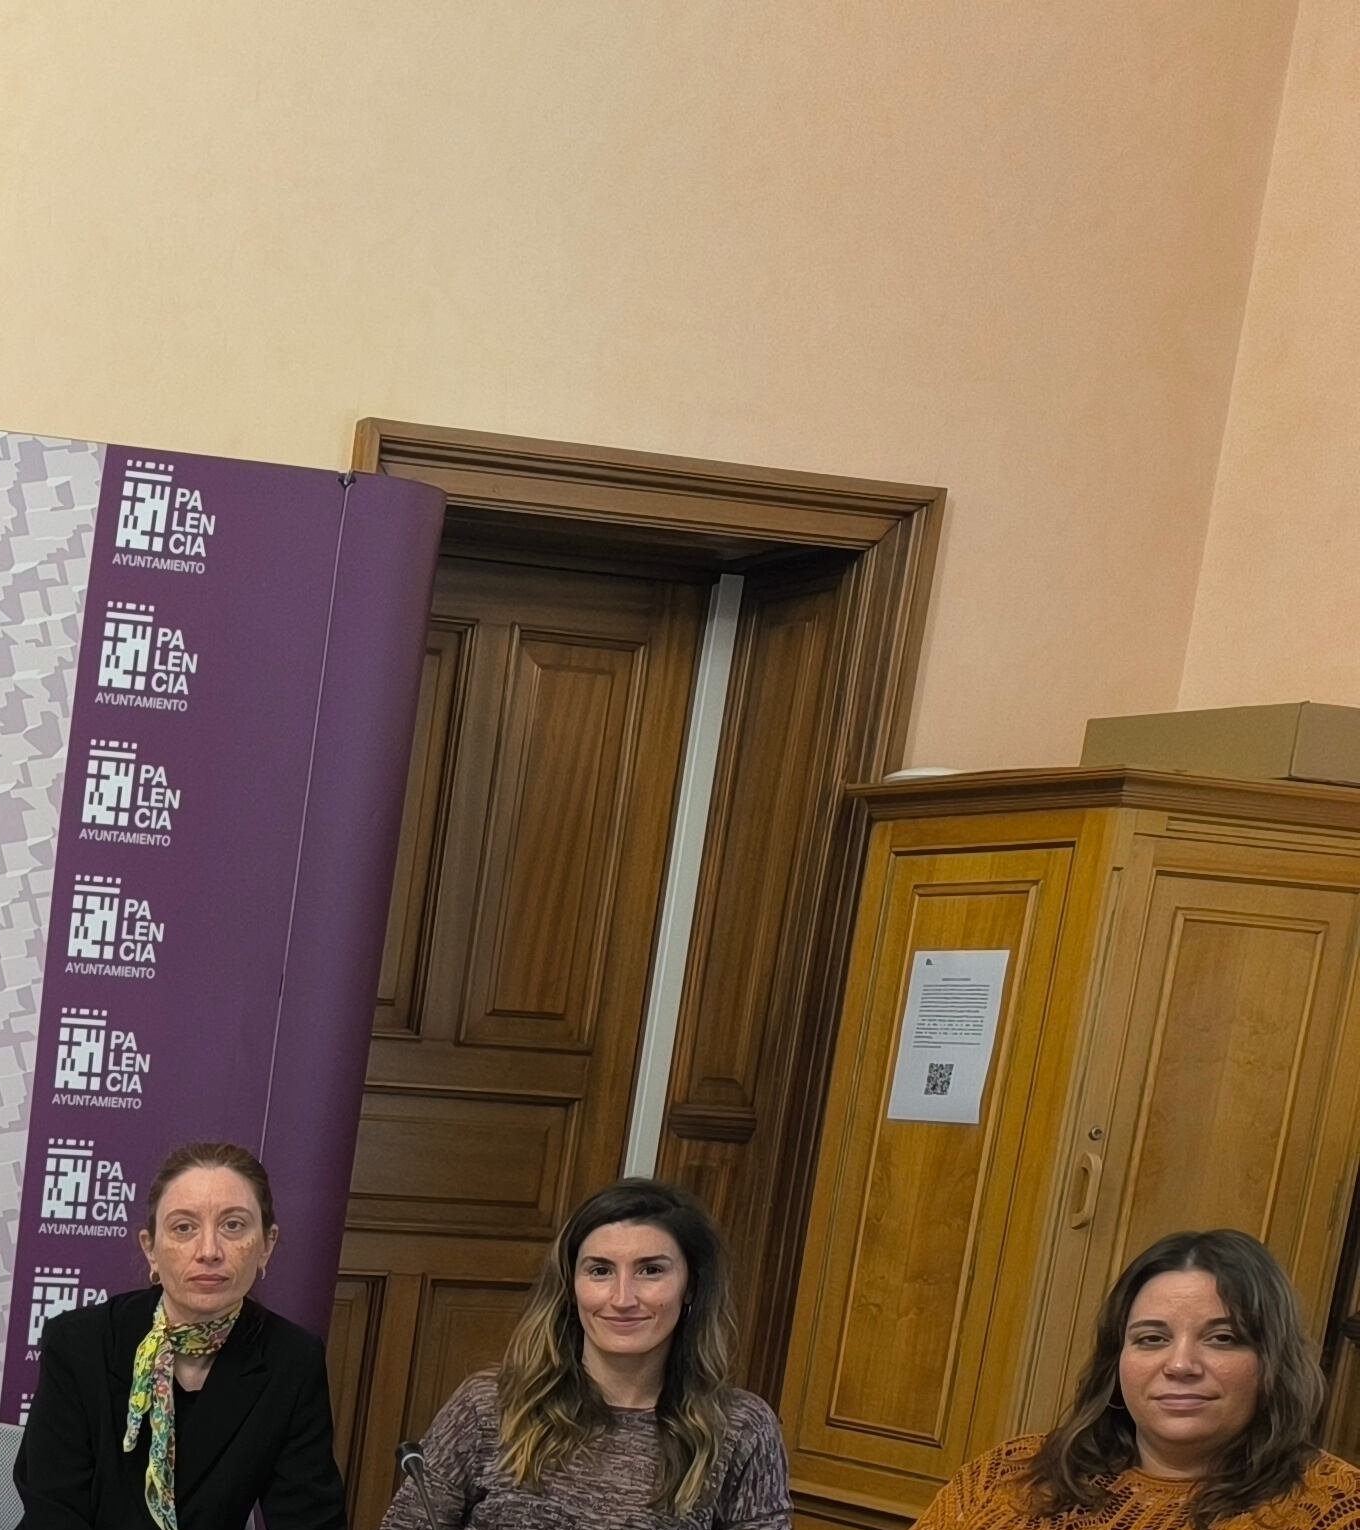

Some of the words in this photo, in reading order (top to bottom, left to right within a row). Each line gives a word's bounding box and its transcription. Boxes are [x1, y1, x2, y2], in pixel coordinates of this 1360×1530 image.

[174, 487, 203, 511] PA
[171, 510, 216, 536] LEN
[168, 533, 207, 557] CIA
[111, 552, 206, 575] AYUNTAMIENTO
[156, 627, 185, 650] PA
[153, 649, 198, 674] LEN
[151, 671, 189, 695] CIA
[94, 691, 188, 712] AYUNTAMIENTO
[139, 764, 168, 786] PA
[136, 786, 181, 809] LEN
[134, 807, 172, 830] CIA
[78, 828, 171, 847] AYUNTAMIENTO
[123, 898, 152, 920] PA
[121, 920, 165, 942] LEN
[119, 941, 156, 963] CIA
[64, 961, 156, 980] AYUNTAMIENTO
[110, 1030, 138, 1051] PA
[108, 1051, 151, 1073] LEN
[106, 1073, 143, 1094] CIA
[51, 1093, 142, 1110] AYUNTAMIENTO
[96, 1160, 124, 1180] PA
[94, 1181, 136, 1202] LEN
[92, 1202, 129, 1223] CIA
[38, 1222, 128, 1238] AYUNTAMIENTO
[82, 1287, 109, 1307] PA
